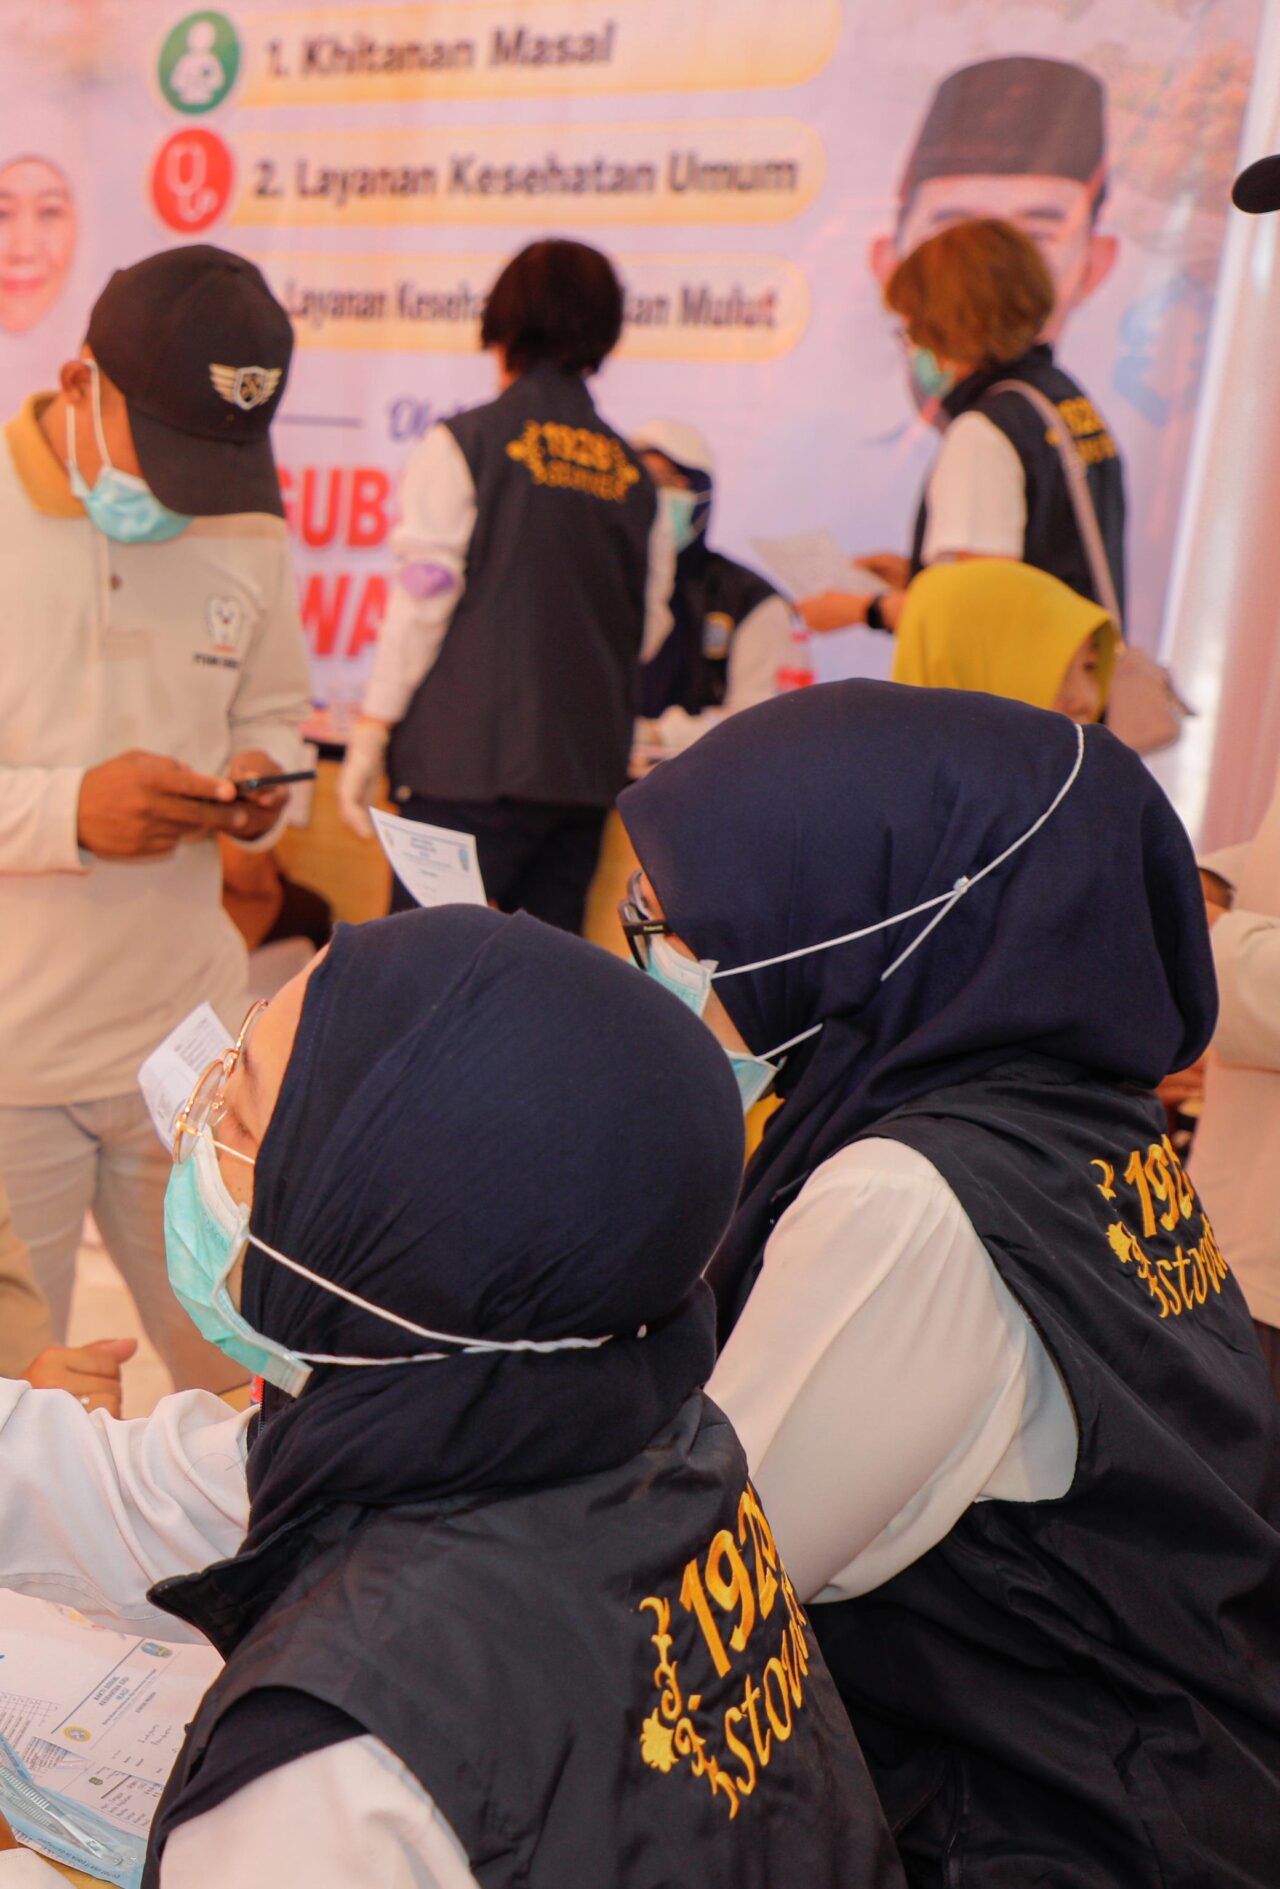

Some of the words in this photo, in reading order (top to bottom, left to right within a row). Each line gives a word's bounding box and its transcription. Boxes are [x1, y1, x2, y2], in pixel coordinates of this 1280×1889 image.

[302, 33, 473, 76] Khitanan
[489, 20, 613, 67] Masal
[254, 160, 283, 197] 2.
[296, 159, 436, 205] Layanan
[450, 153, 655, 196] Kesehatan
[668, 152, 798, 193] Umum
[399, 280, 484, 321] Keseh
[680, 284, 777, 327] Mulut
